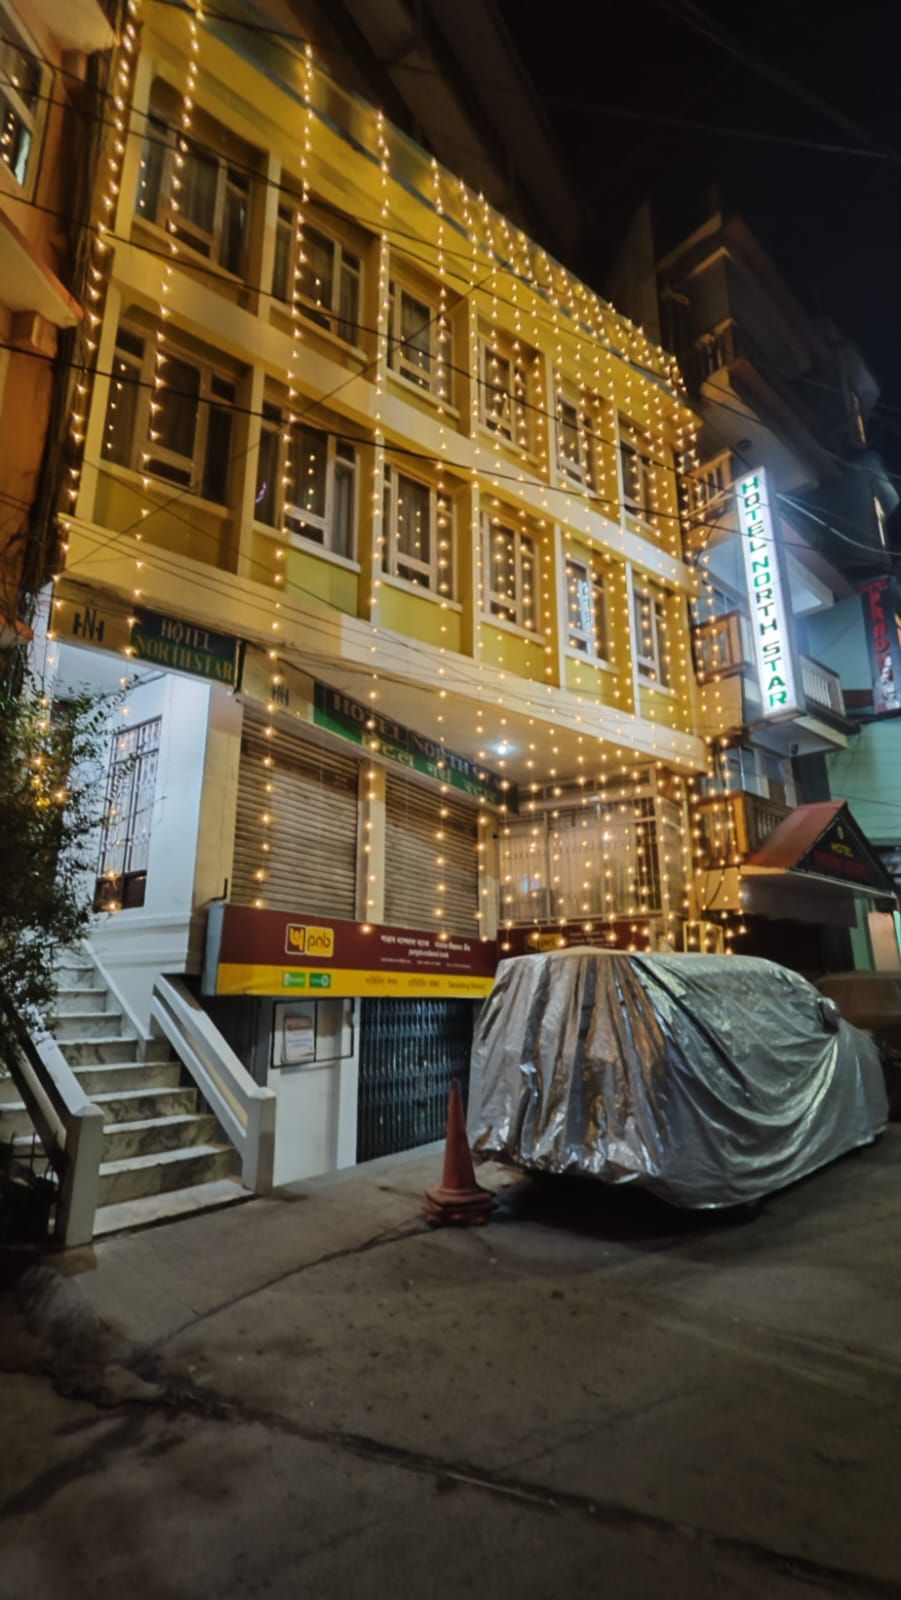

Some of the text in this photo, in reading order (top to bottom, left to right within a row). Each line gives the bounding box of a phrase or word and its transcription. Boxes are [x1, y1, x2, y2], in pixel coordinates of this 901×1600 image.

[742, 475, 788, 707] HOTEL NORTH STAR
[161, 617, 212, 653] HOTEL
[307, 931, 331, 950] pnb
